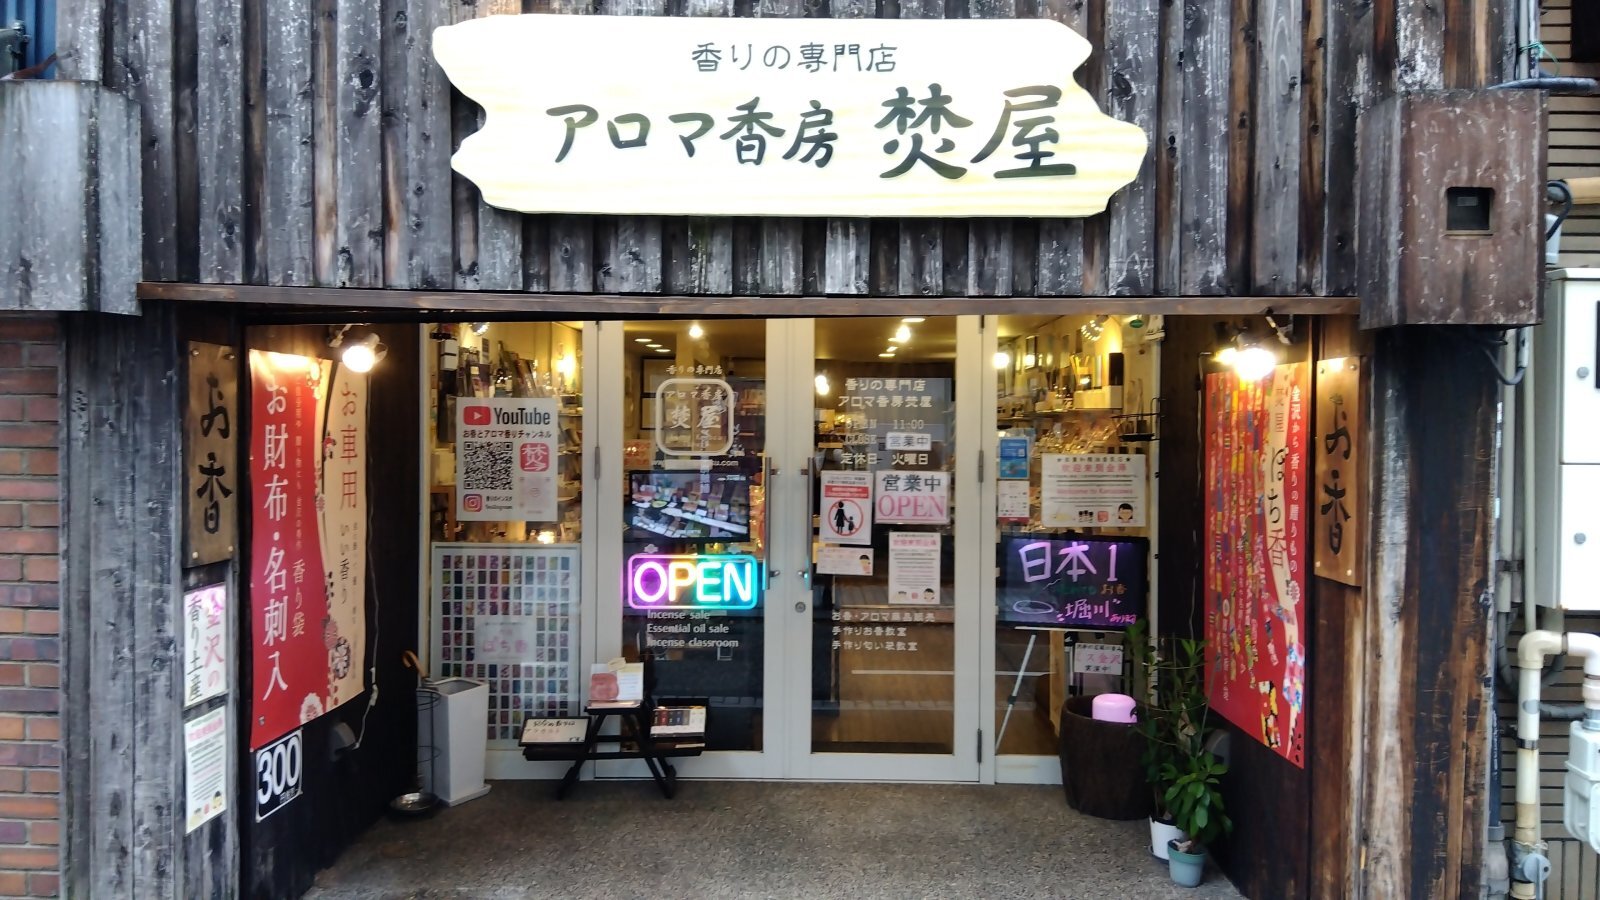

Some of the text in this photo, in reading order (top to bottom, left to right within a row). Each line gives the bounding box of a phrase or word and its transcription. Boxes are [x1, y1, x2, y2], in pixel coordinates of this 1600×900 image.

[691, 42, 899, 72] 香りの専門店
[546, 82, 1077, 181] アロマ香房 焚屋
[845, 379, 926, 391] 香りの専門店
[838, 395, 933, 408] アロマ香房焚屋
[494, 407, 551, 425] YouTube
[196, 371, 233, 535] お香
[340, 382, 358, 510] お車用
[840, 453, 929, 465] 定休日 火曜日
[882, 474, 941, 493] 営業中
[1320, 393, 1352, 555] お香
[878, 495, 945, 518] OPEN
[633, 561, 752, 602] OPEN
[647, 610, 711, 620] Incense sale
[646, 623, 730, 634] Essential oil sale
[646, 637, 739, 648] Incense classroom
[257, 736, 300, 806] 300
